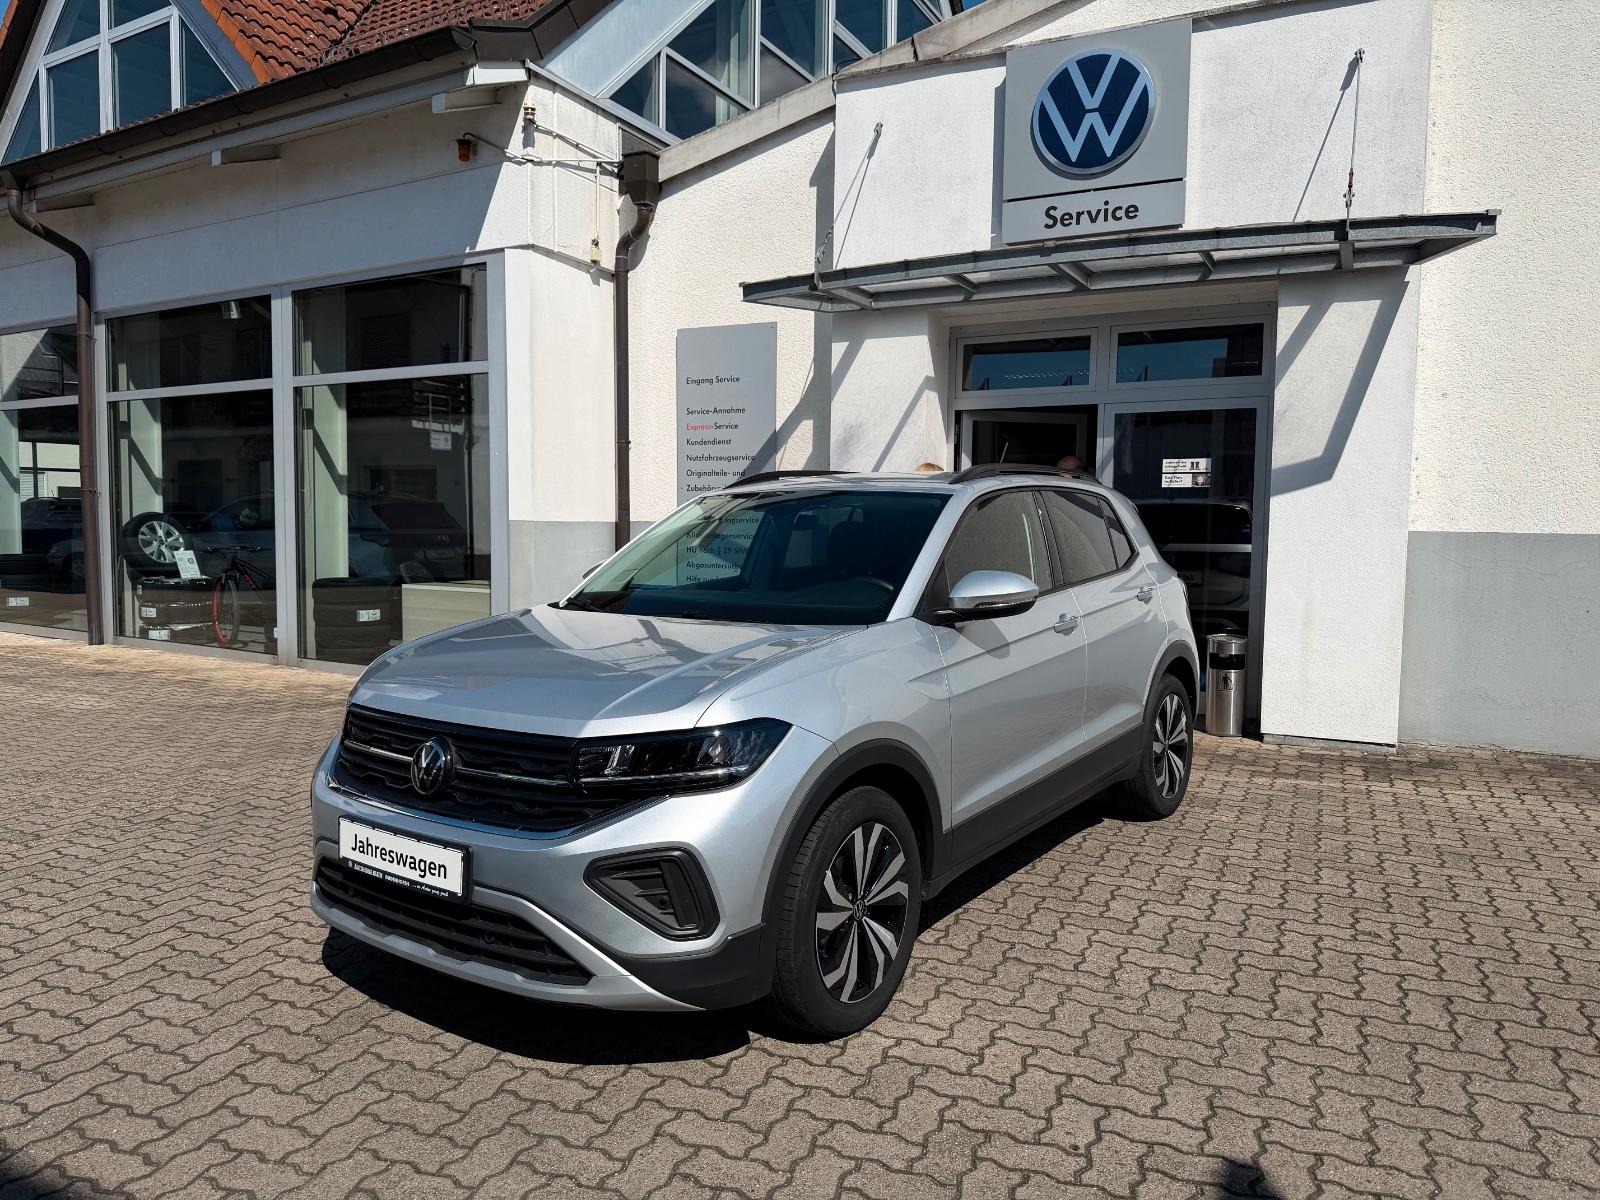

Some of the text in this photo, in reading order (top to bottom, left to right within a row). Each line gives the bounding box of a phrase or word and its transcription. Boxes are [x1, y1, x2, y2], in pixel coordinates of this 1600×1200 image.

[1043, 200, 1139, 229] Service
[686, 375, 740, 386] Eingang Service
[686, 406, 746, 416] Service-Annahme
[686, 422, 739, 431] Express-Service
[686, 437, 732, 446] Kundendienst
[686, 453, 756, 462] Nutzfahrzeugservice
[686, 468, 746, 479] Originalteile- und
[351, 833, 447, 880] Jahreswagen
